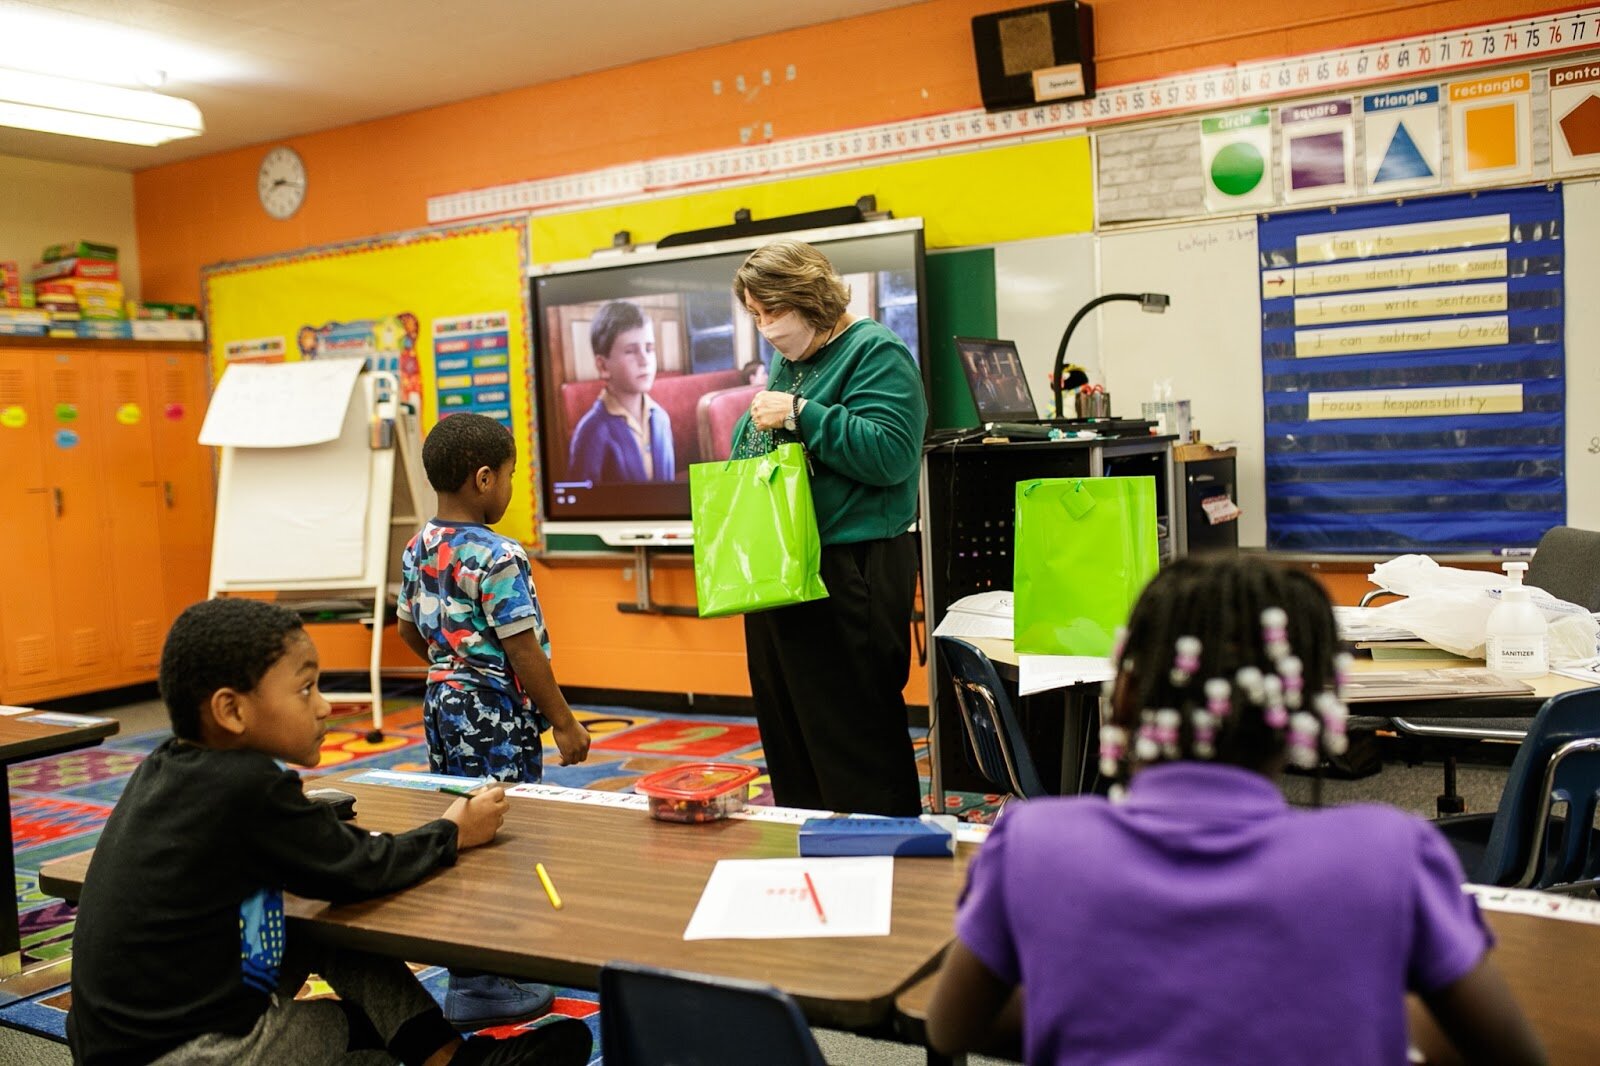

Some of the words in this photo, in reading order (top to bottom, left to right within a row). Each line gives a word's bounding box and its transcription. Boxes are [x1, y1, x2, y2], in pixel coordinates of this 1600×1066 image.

[925, 127, 935, 141] 42
[940, 124, 951, 139] 43
[955, 121, 966, 137] 44
[971, 118, 981, 134] 45
[986, 117, 996, 132] 46
[1002, 114, 1012, 129] 47
[1017, 111, 1028, 127] 48
[1034, 109, 1045, 124] 49
[1050, 105, 1061, 121] 50
[1066, 103, 1076, 119] 51
[1082, 101, 1094, 117] 52
[1100, 98, 1111, 114] 53
[1116, 95, 1127, 111] 54
[1132, 92, 1144, 108] 55
[1150, 90, 1161, 106] 56
[1168, 87, 1179, 103] 57
[1186, 85, 1196, 101] 58
[1204, 81, 1215, 98] 59
[1222, 77, 1234, 94] 60
[1242, 74, 1251, 91] 61
[1259, 71, 1271, 88] 62
[1278, 68, 1290, 86] 63
[1297, 66, 1309, 83] 64
[1317, 62, 1329, 80] 65
[1336, 59, 1349, 76] 66
[1357, 56, 1369, 73] 67
[1377, 53, 1390, 70] 68
[1397, 50, 1409, 67] 69
[1418, 46, 1431, 64] 70
[1440, 43, 1450, 61] 71
[1460, 40, 1473, 58] 72
[1482, 36, 1495, 54] 73
[1504, 32, 1517, 50] 74
[1526, 29, 1540, 47] 75
[1549, 25, 1562, 44] 76
[1571, 21, 1585, 41] 77
[1454, 76, 1524, 98] rectangle
[1373, 89, 1428, 109] triangle
[1217, 114, 1251, 129] circle
[1293, 103, 1338, 121] square
[1307, 271, 1318, 288] I
[1327, 273, 1350, 284] can
[1365, 261, 1414, 283] identify
[1427, 260, 1457, 275] letter
[1468, 255, 1505, 271] sounds
[1317, 301, 1327, 316] I
[1341, 303, 1366, 314] can
[1384, 296, 1418, 311] write
[1436, 292, 1503, 308] sentences
[1316, 334, 1325, 348] I
[1340, 335, 1362, 346] can
[1379, 330, 1432, 344] subtract
[1384, 391, 1488, 414] Responsibility
